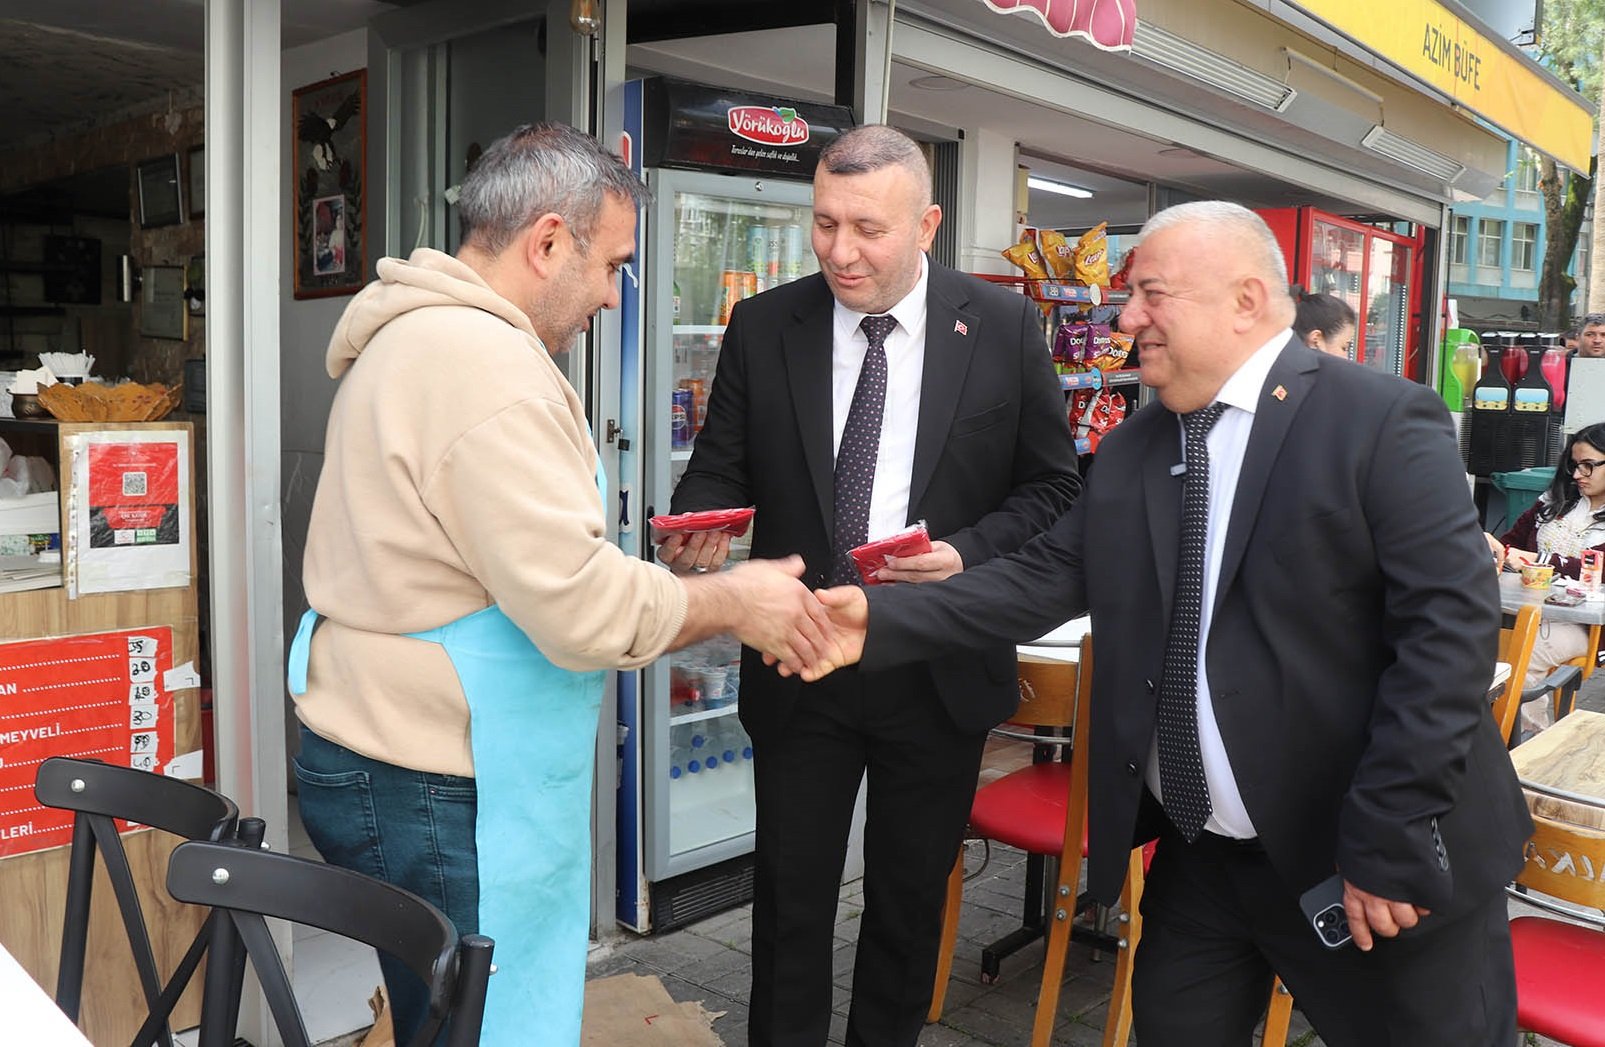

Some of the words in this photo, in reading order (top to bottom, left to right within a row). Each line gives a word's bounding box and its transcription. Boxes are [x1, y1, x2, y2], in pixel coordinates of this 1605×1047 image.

[1422, 22, 1451, 72] AZİM
[1454, 39, 1481, 91] BÜFE
[128, 639, 144, 654] 35
[132, 661, 151, 676] 20
[133, 710, 153, 726] 30
[0, 821, 33, 840] LERİ
